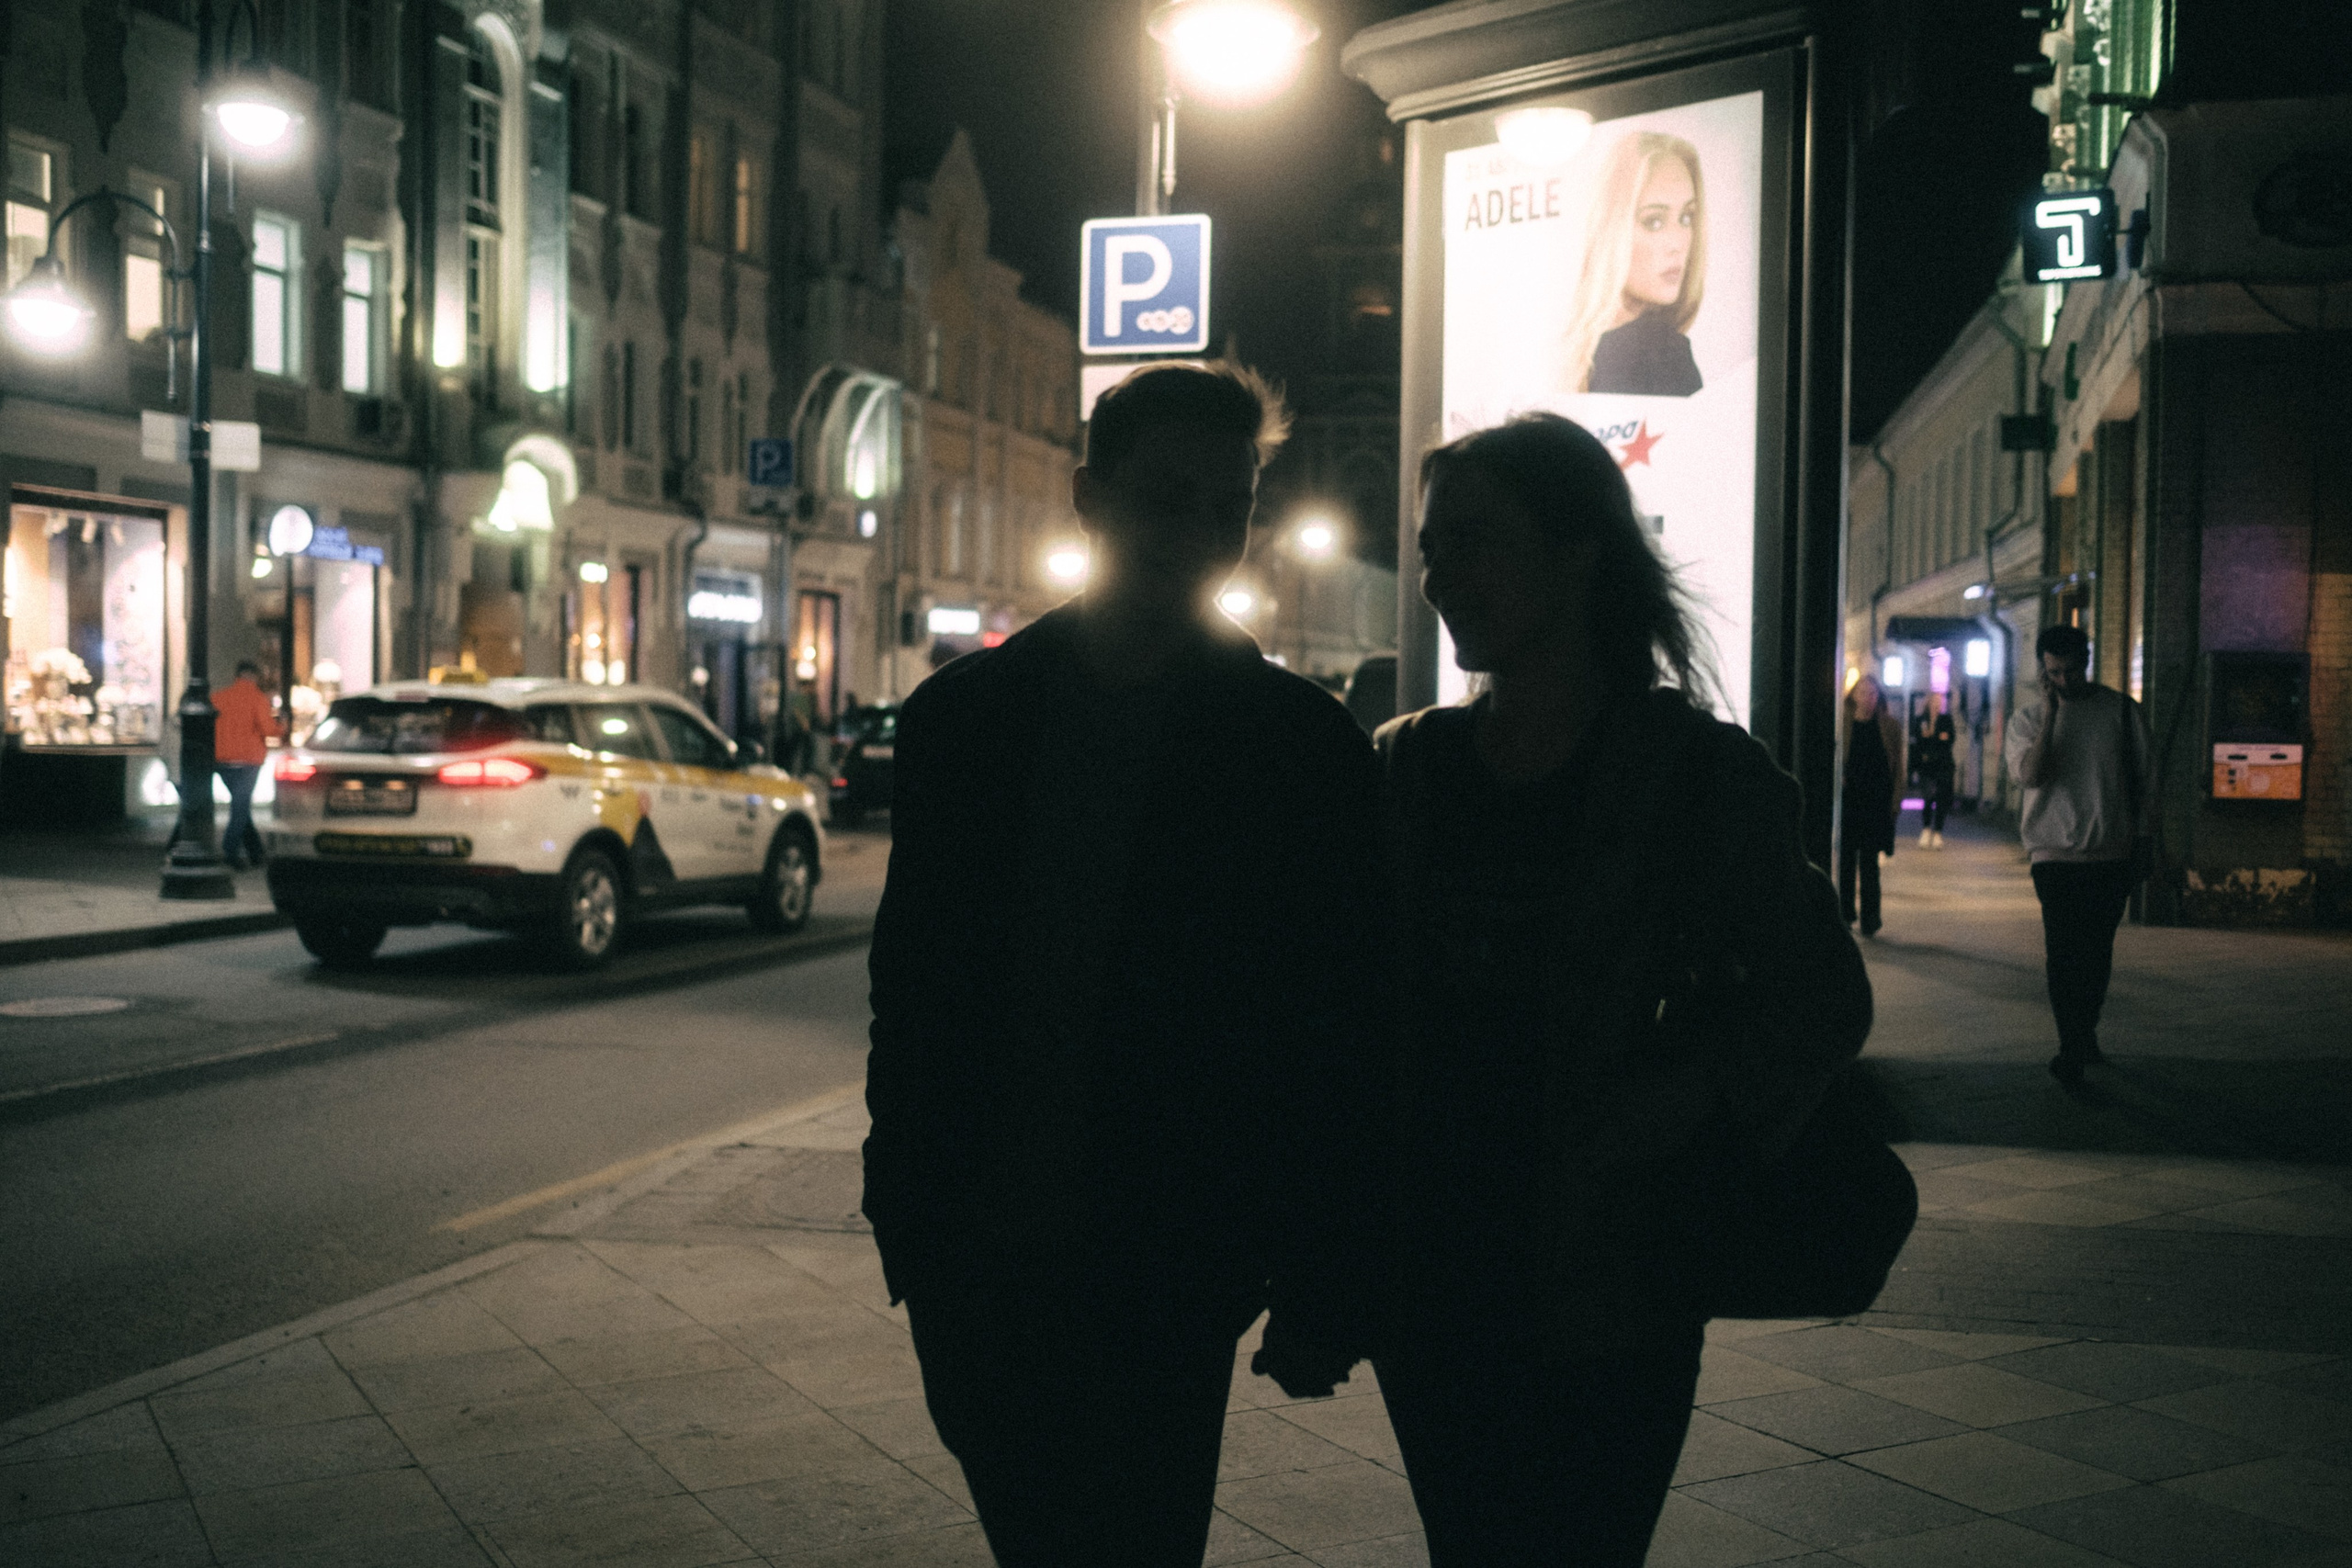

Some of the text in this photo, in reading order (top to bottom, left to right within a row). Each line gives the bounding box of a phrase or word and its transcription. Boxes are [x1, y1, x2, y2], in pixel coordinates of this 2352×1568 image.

[1464, 178, 1561, 231] ADELE
[1104, 234, 1173, 338] P
[756, 446, 781, 479] P
